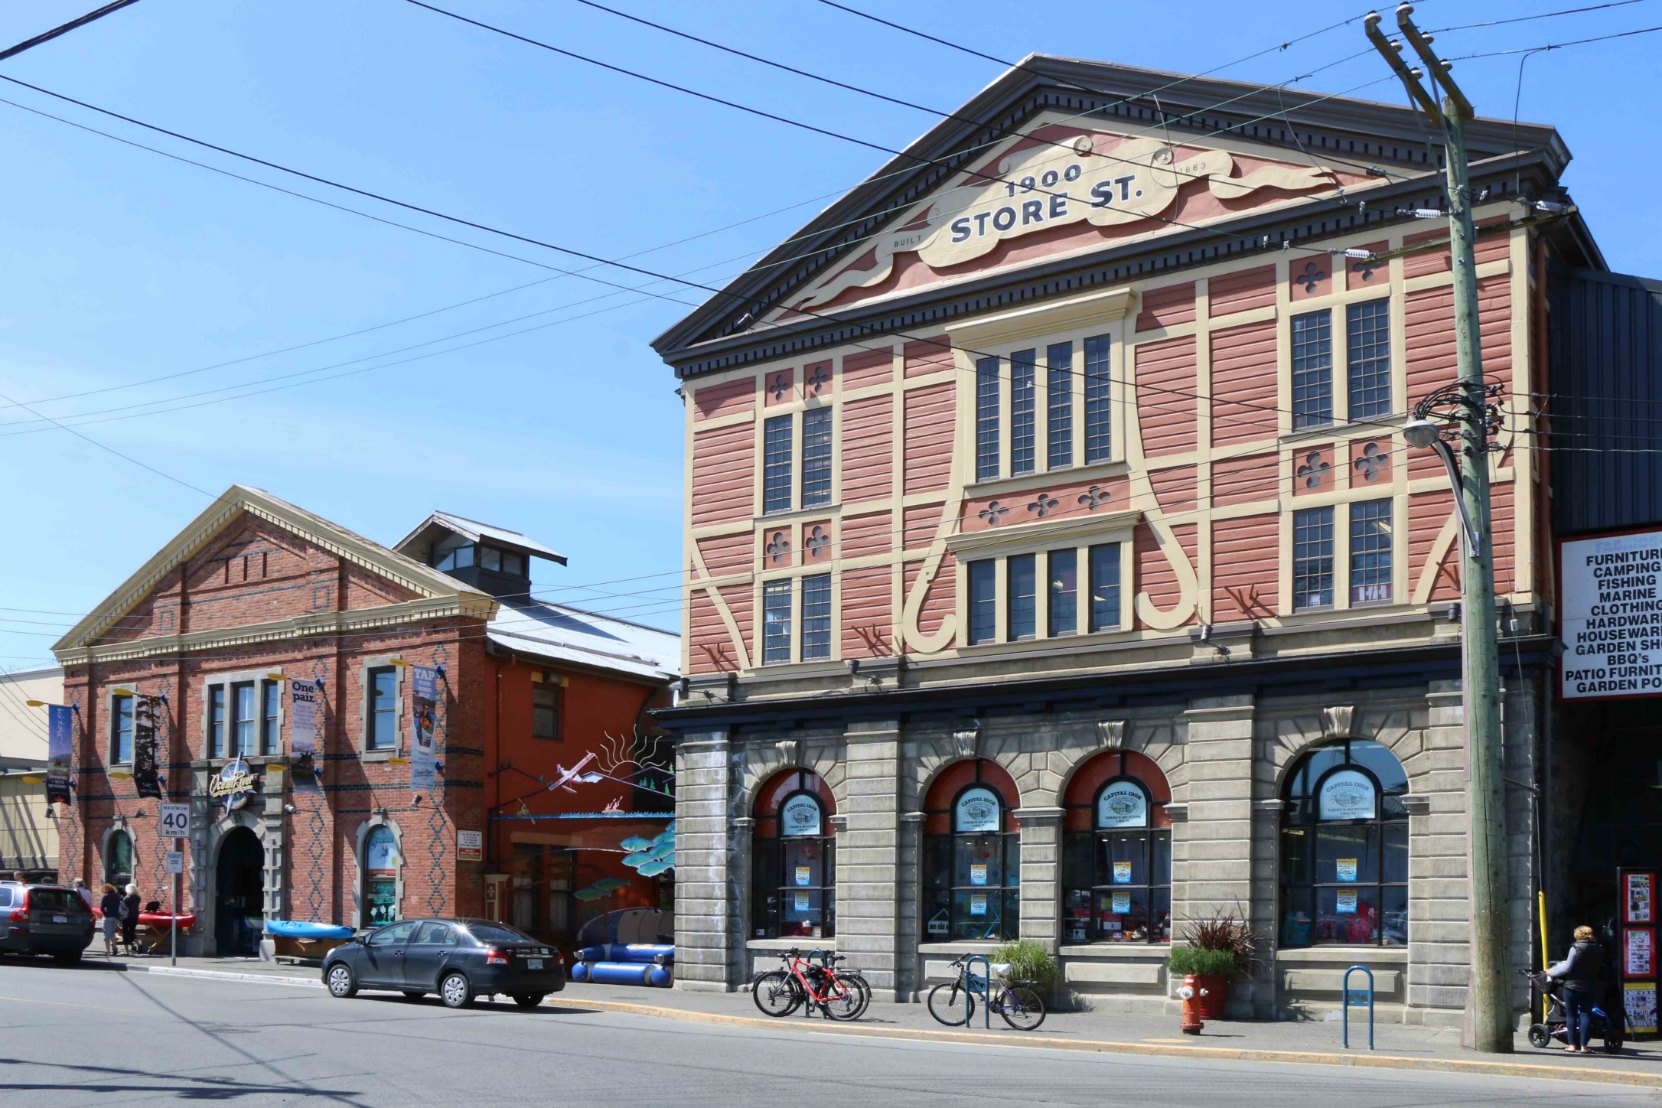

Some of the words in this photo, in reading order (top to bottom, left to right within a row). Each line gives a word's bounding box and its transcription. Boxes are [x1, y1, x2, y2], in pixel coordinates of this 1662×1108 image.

[1180, 162, 1206, 174] 1863
[1004, 164, 1082, 197] 1900
[950, 192, 1068, 243] STORE
[1089, 174, 1143, 209] ST.
[894, 235, 921, 248] BUILT
[1586, 549, 1662, 567] FURNITUR
[1593, 561, 1661, 578] CAMPING
[1598, 575, 1656, 591] FISHING
[1599, 588, 1656, 603] MARINE
[1591, 600, 1662, 616] CLOTHING
[1586, 613, 1662, 630] HARDWAR
[1577, 626, 1662, 643] HOUSEWAR
[1576, 641, 1636, 656] GARDEN
[1640, 639, 1662, 651] SH
[1607, 653, 1649, 666] BBQ's
[414, 668, 435, 681] TAP
[1565, 668, 1606, 681] PATIO
[1609, 664, 1662, 678] FURNIT
[292, 681, 314, 693] One
[1577, 679, 1637, 693] GARDEN
[1641, 677, 1662, 689] PO
[1103, 790, 1127, 801] CAPITAL
[163, 813, 188, 829] 40
